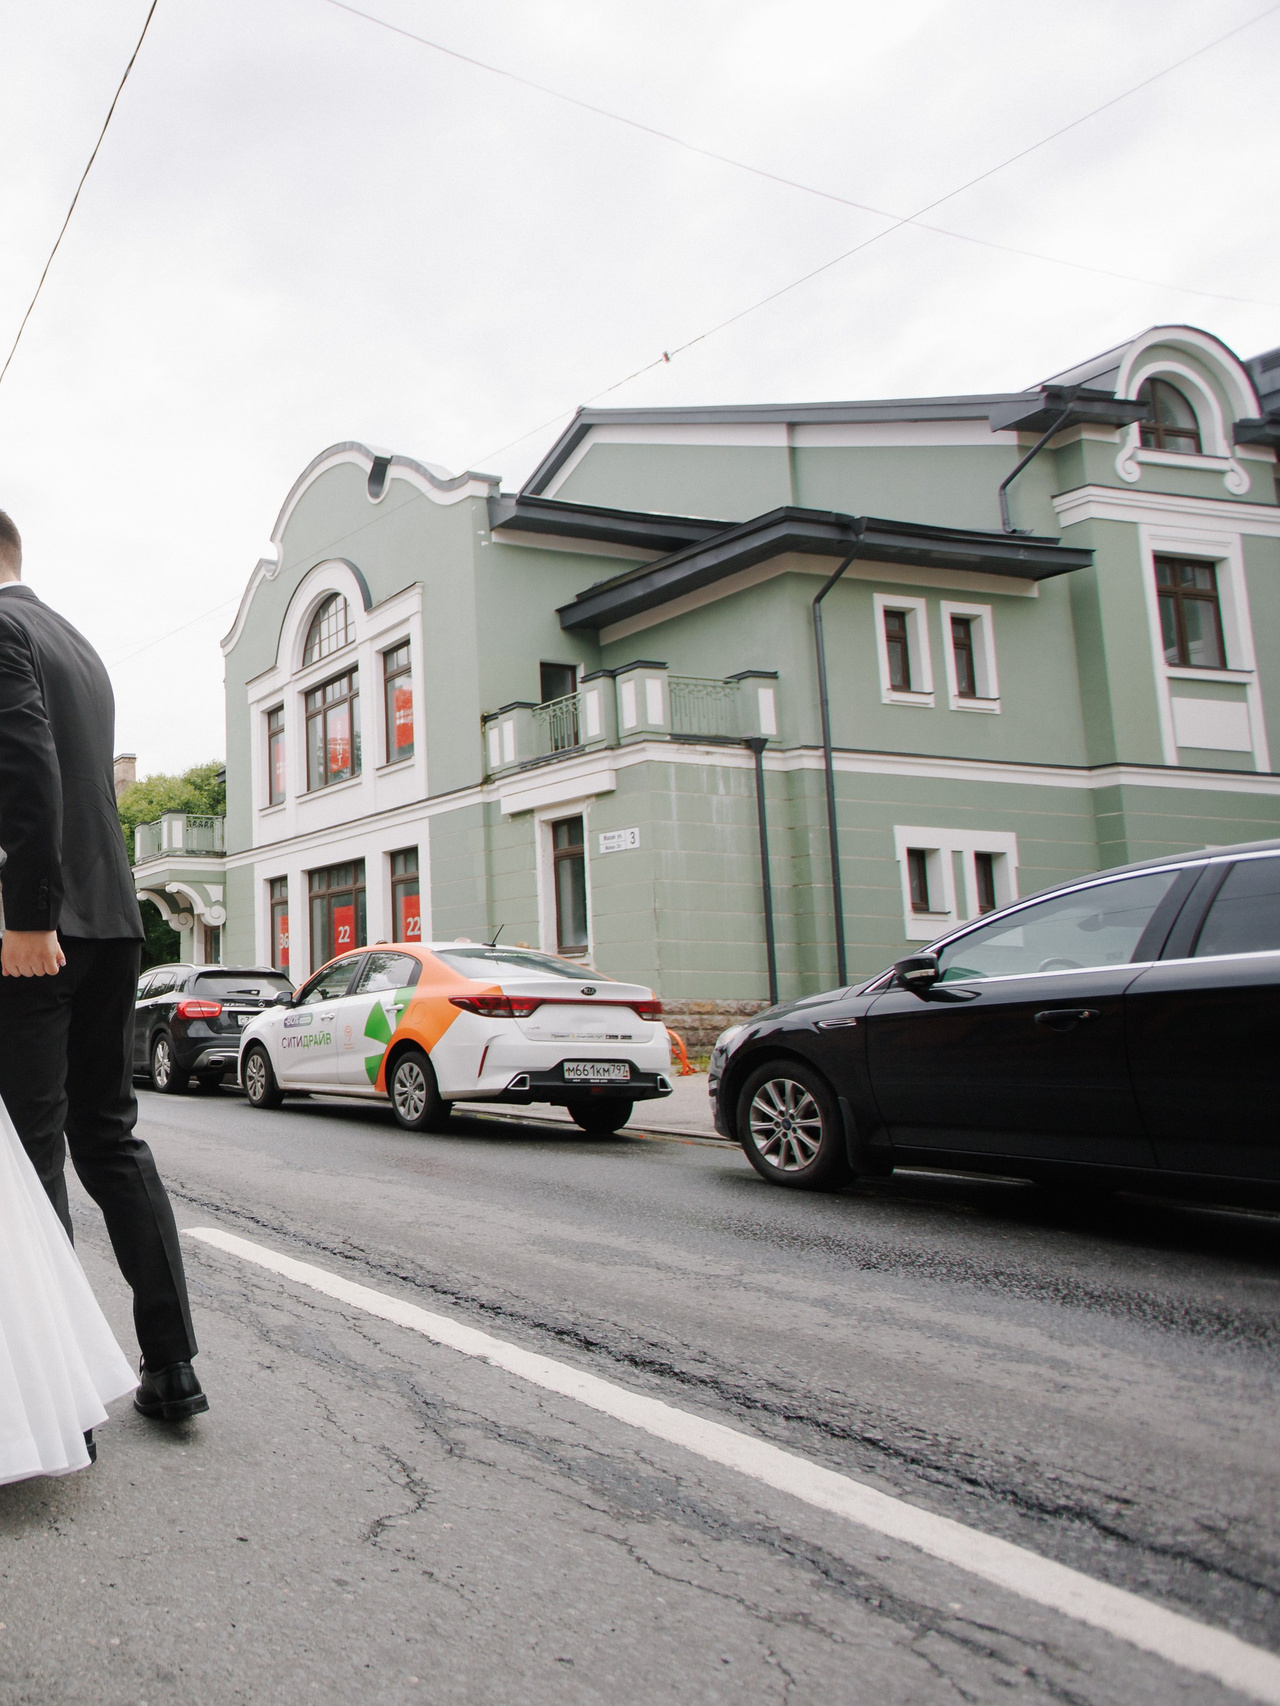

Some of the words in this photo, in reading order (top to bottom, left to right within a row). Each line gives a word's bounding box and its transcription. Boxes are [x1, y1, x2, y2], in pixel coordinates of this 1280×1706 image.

[630, 831, 636, 845] 3
[338, 925, 350, 943] 22
[406, 916, 421, 936] 22
[279, 932, 289, 949] 36
[281, 1030, 332, 1049] СИТИДРАЙВ
